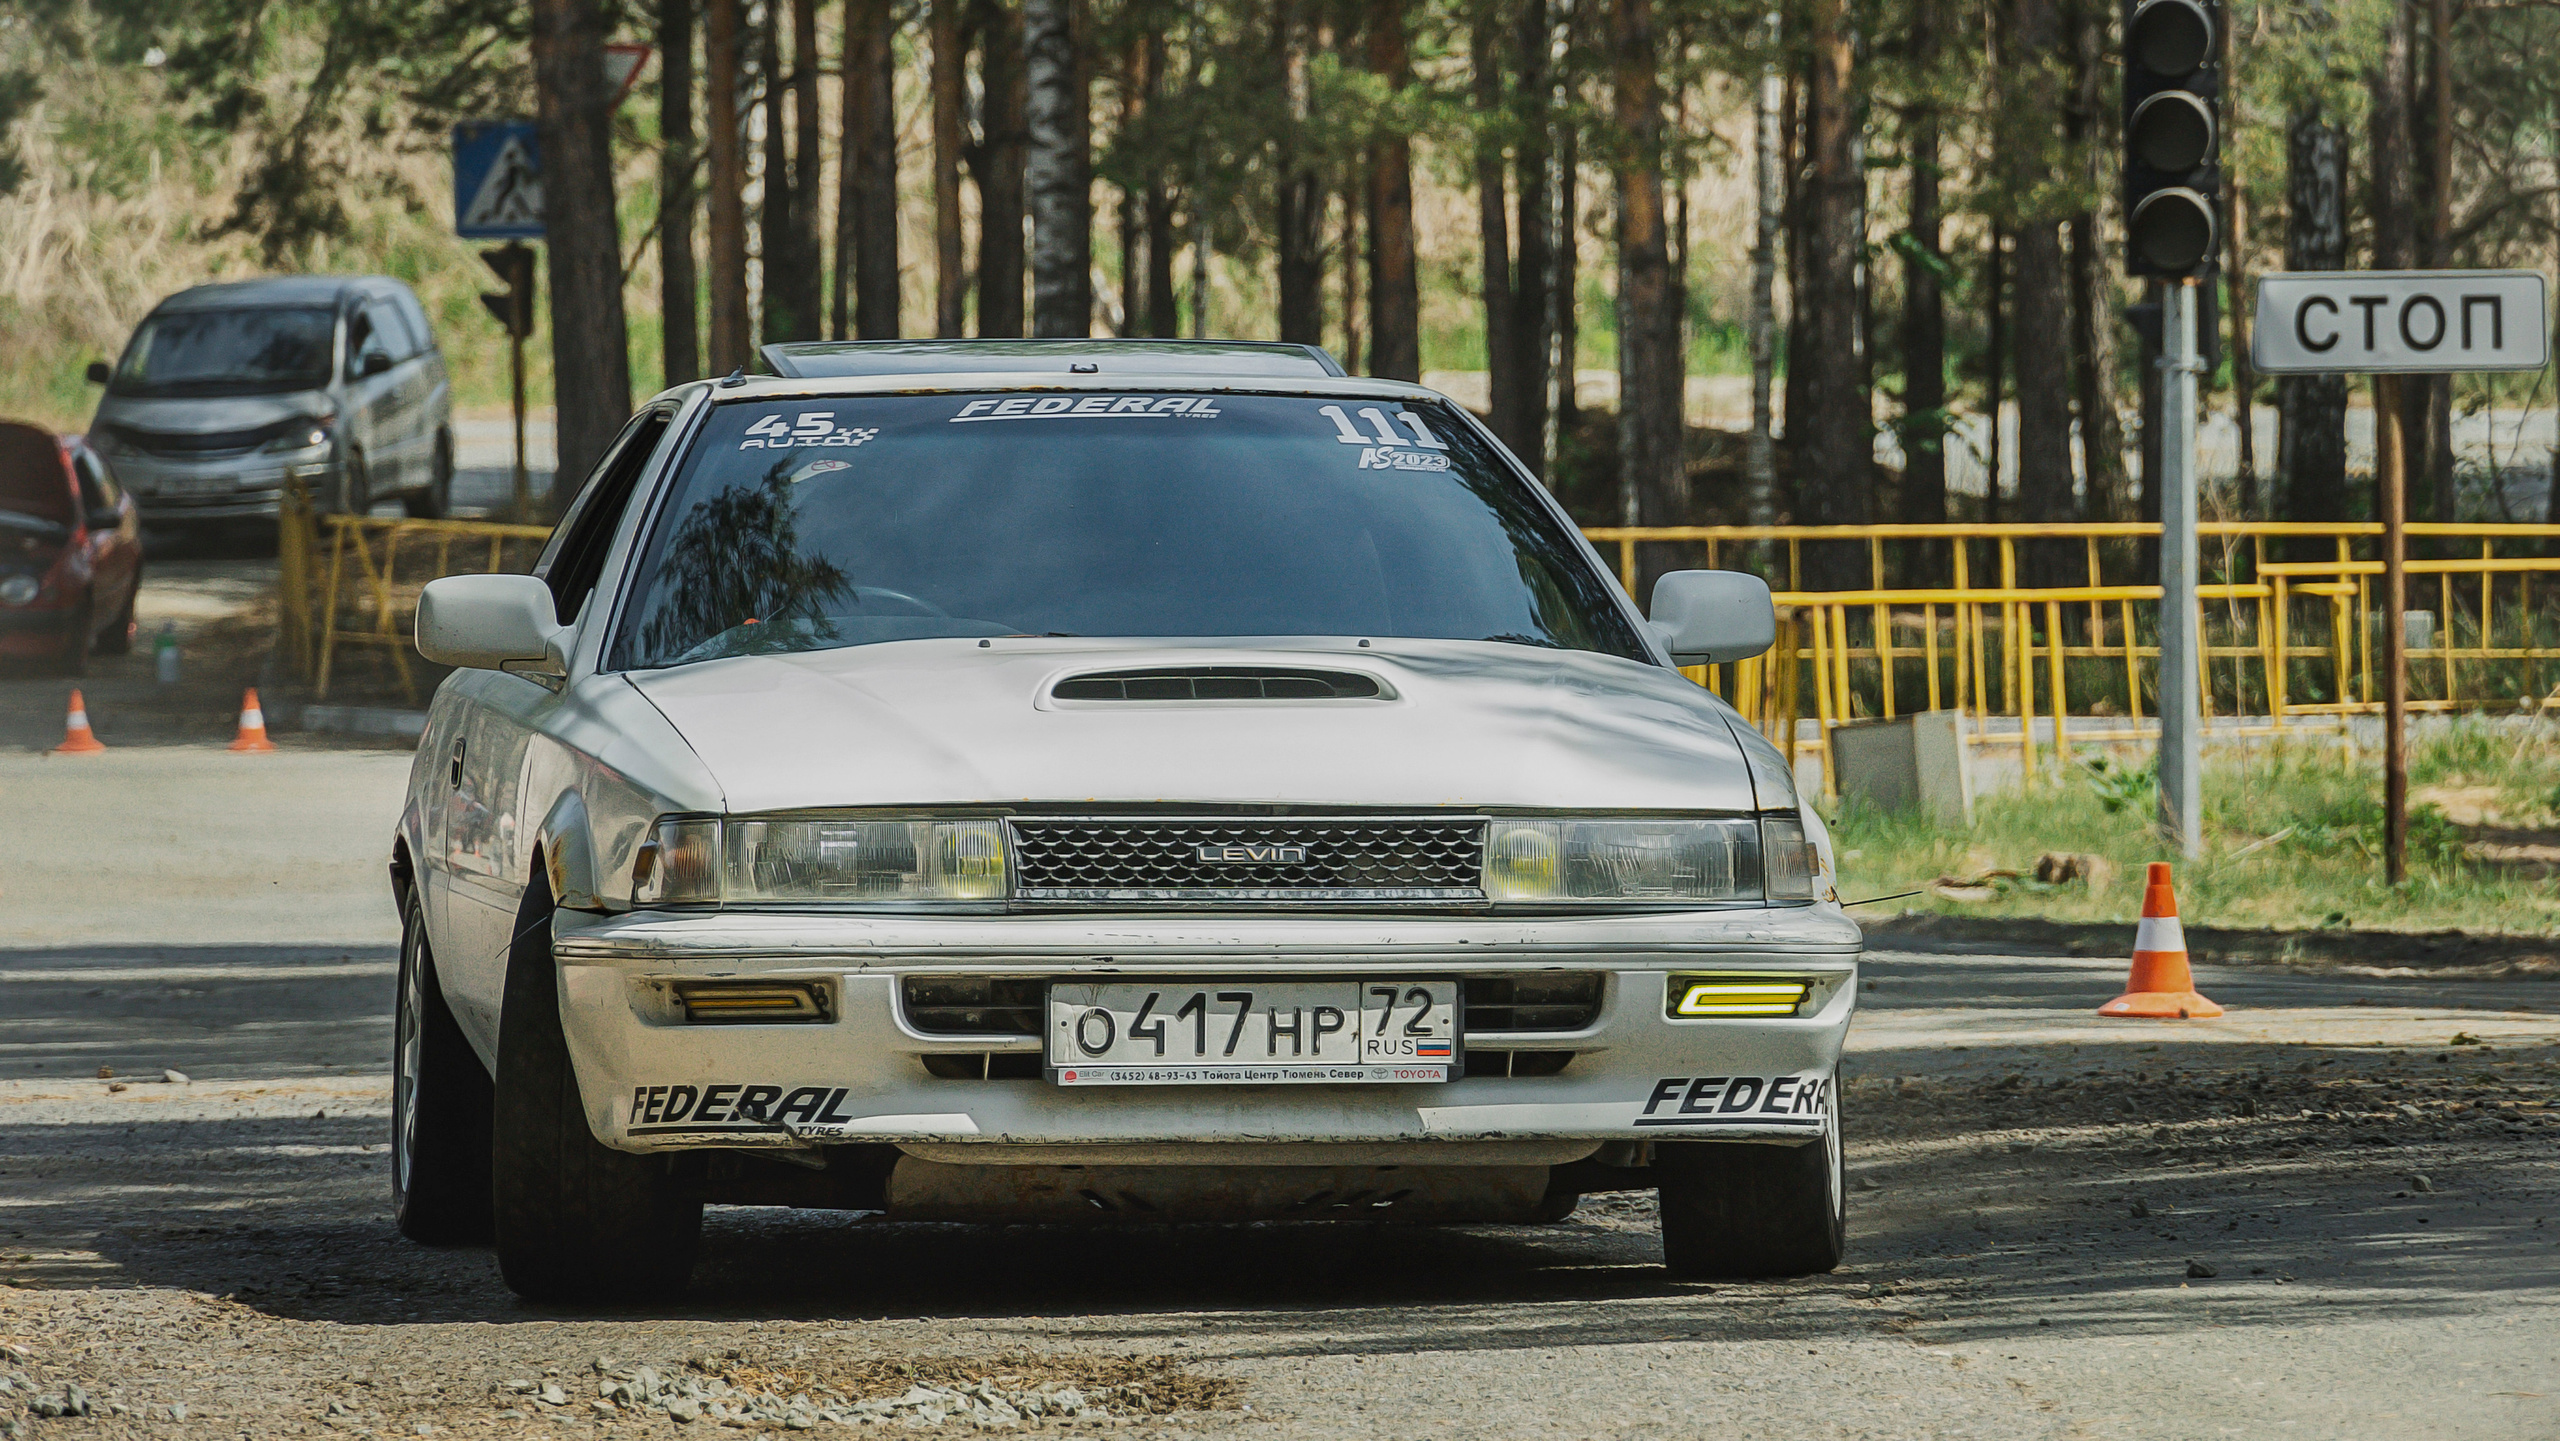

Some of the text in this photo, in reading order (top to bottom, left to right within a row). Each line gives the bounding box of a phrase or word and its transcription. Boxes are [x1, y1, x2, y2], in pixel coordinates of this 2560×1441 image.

[2295, 294, 2502, 352] СТОП
[957, 397, 1222, 417] FEDERAL
[744, 412, 835, 437] 45
[1318, 405, 1450, 450] 111
[739, 436, 852, 450] AUTO
[1199, 847, 1303, 862] LEVIN
[1370, 986, 1434, 1036] 72
[1367, 1039, 1413, 1055] RUS
[1110, 1069, 1364, 1081] (3452) 48-93-43 Тойота Центр Тюмень Север
[1393, 1070, 1441, 1079] TOYOTA
[629, 1085, 853, 1124] FEDERAL
[797, 1126, 844, 1136] TYRES
